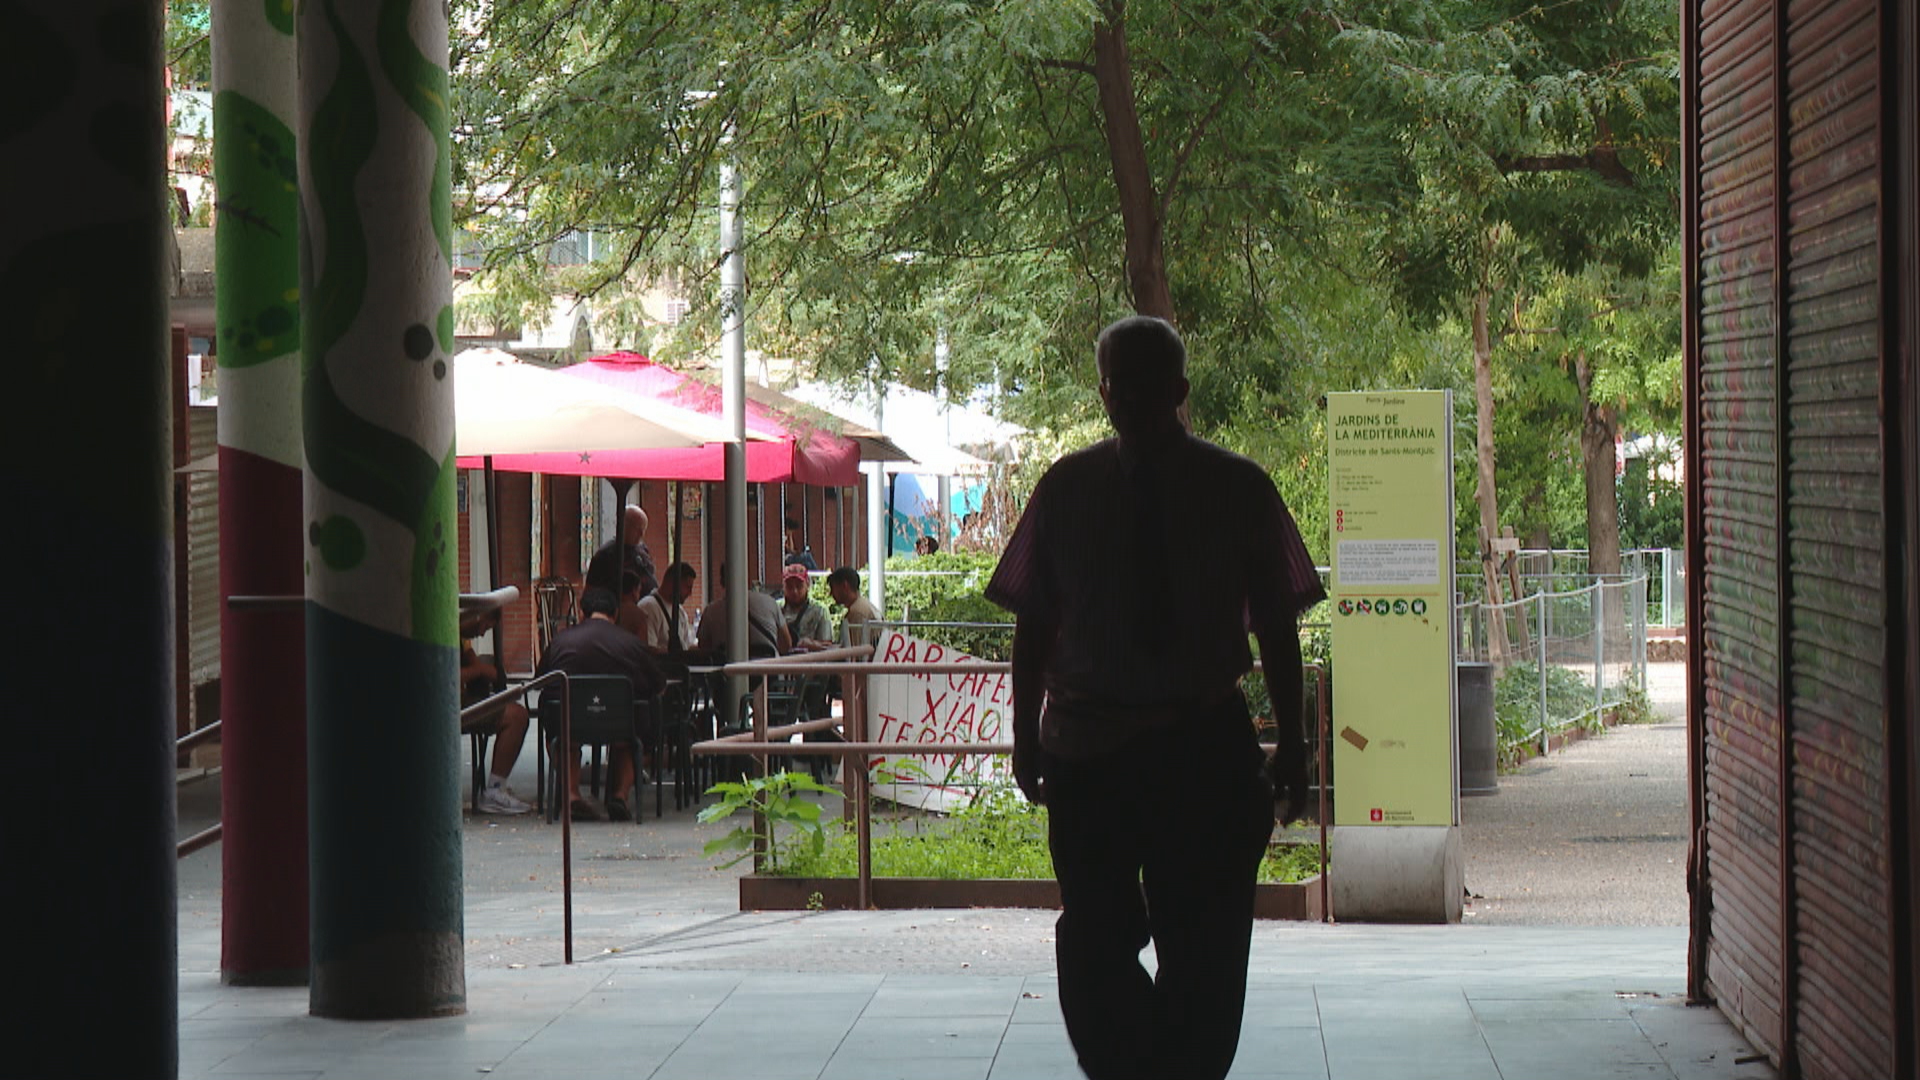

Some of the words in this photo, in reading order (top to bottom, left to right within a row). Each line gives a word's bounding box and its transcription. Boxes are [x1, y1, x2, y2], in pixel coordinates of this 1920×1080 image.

[1335, 414, 1381, 427] JARDINS
[1385, 414, 1399, 425] DE
[1335, 429, 1349, 441] LA
[1353, 426, 1436, 441] MEDITERRÀNIA
[1335, 447, 1366, 456] Districte
[1369, 447, 1378, 455] de
